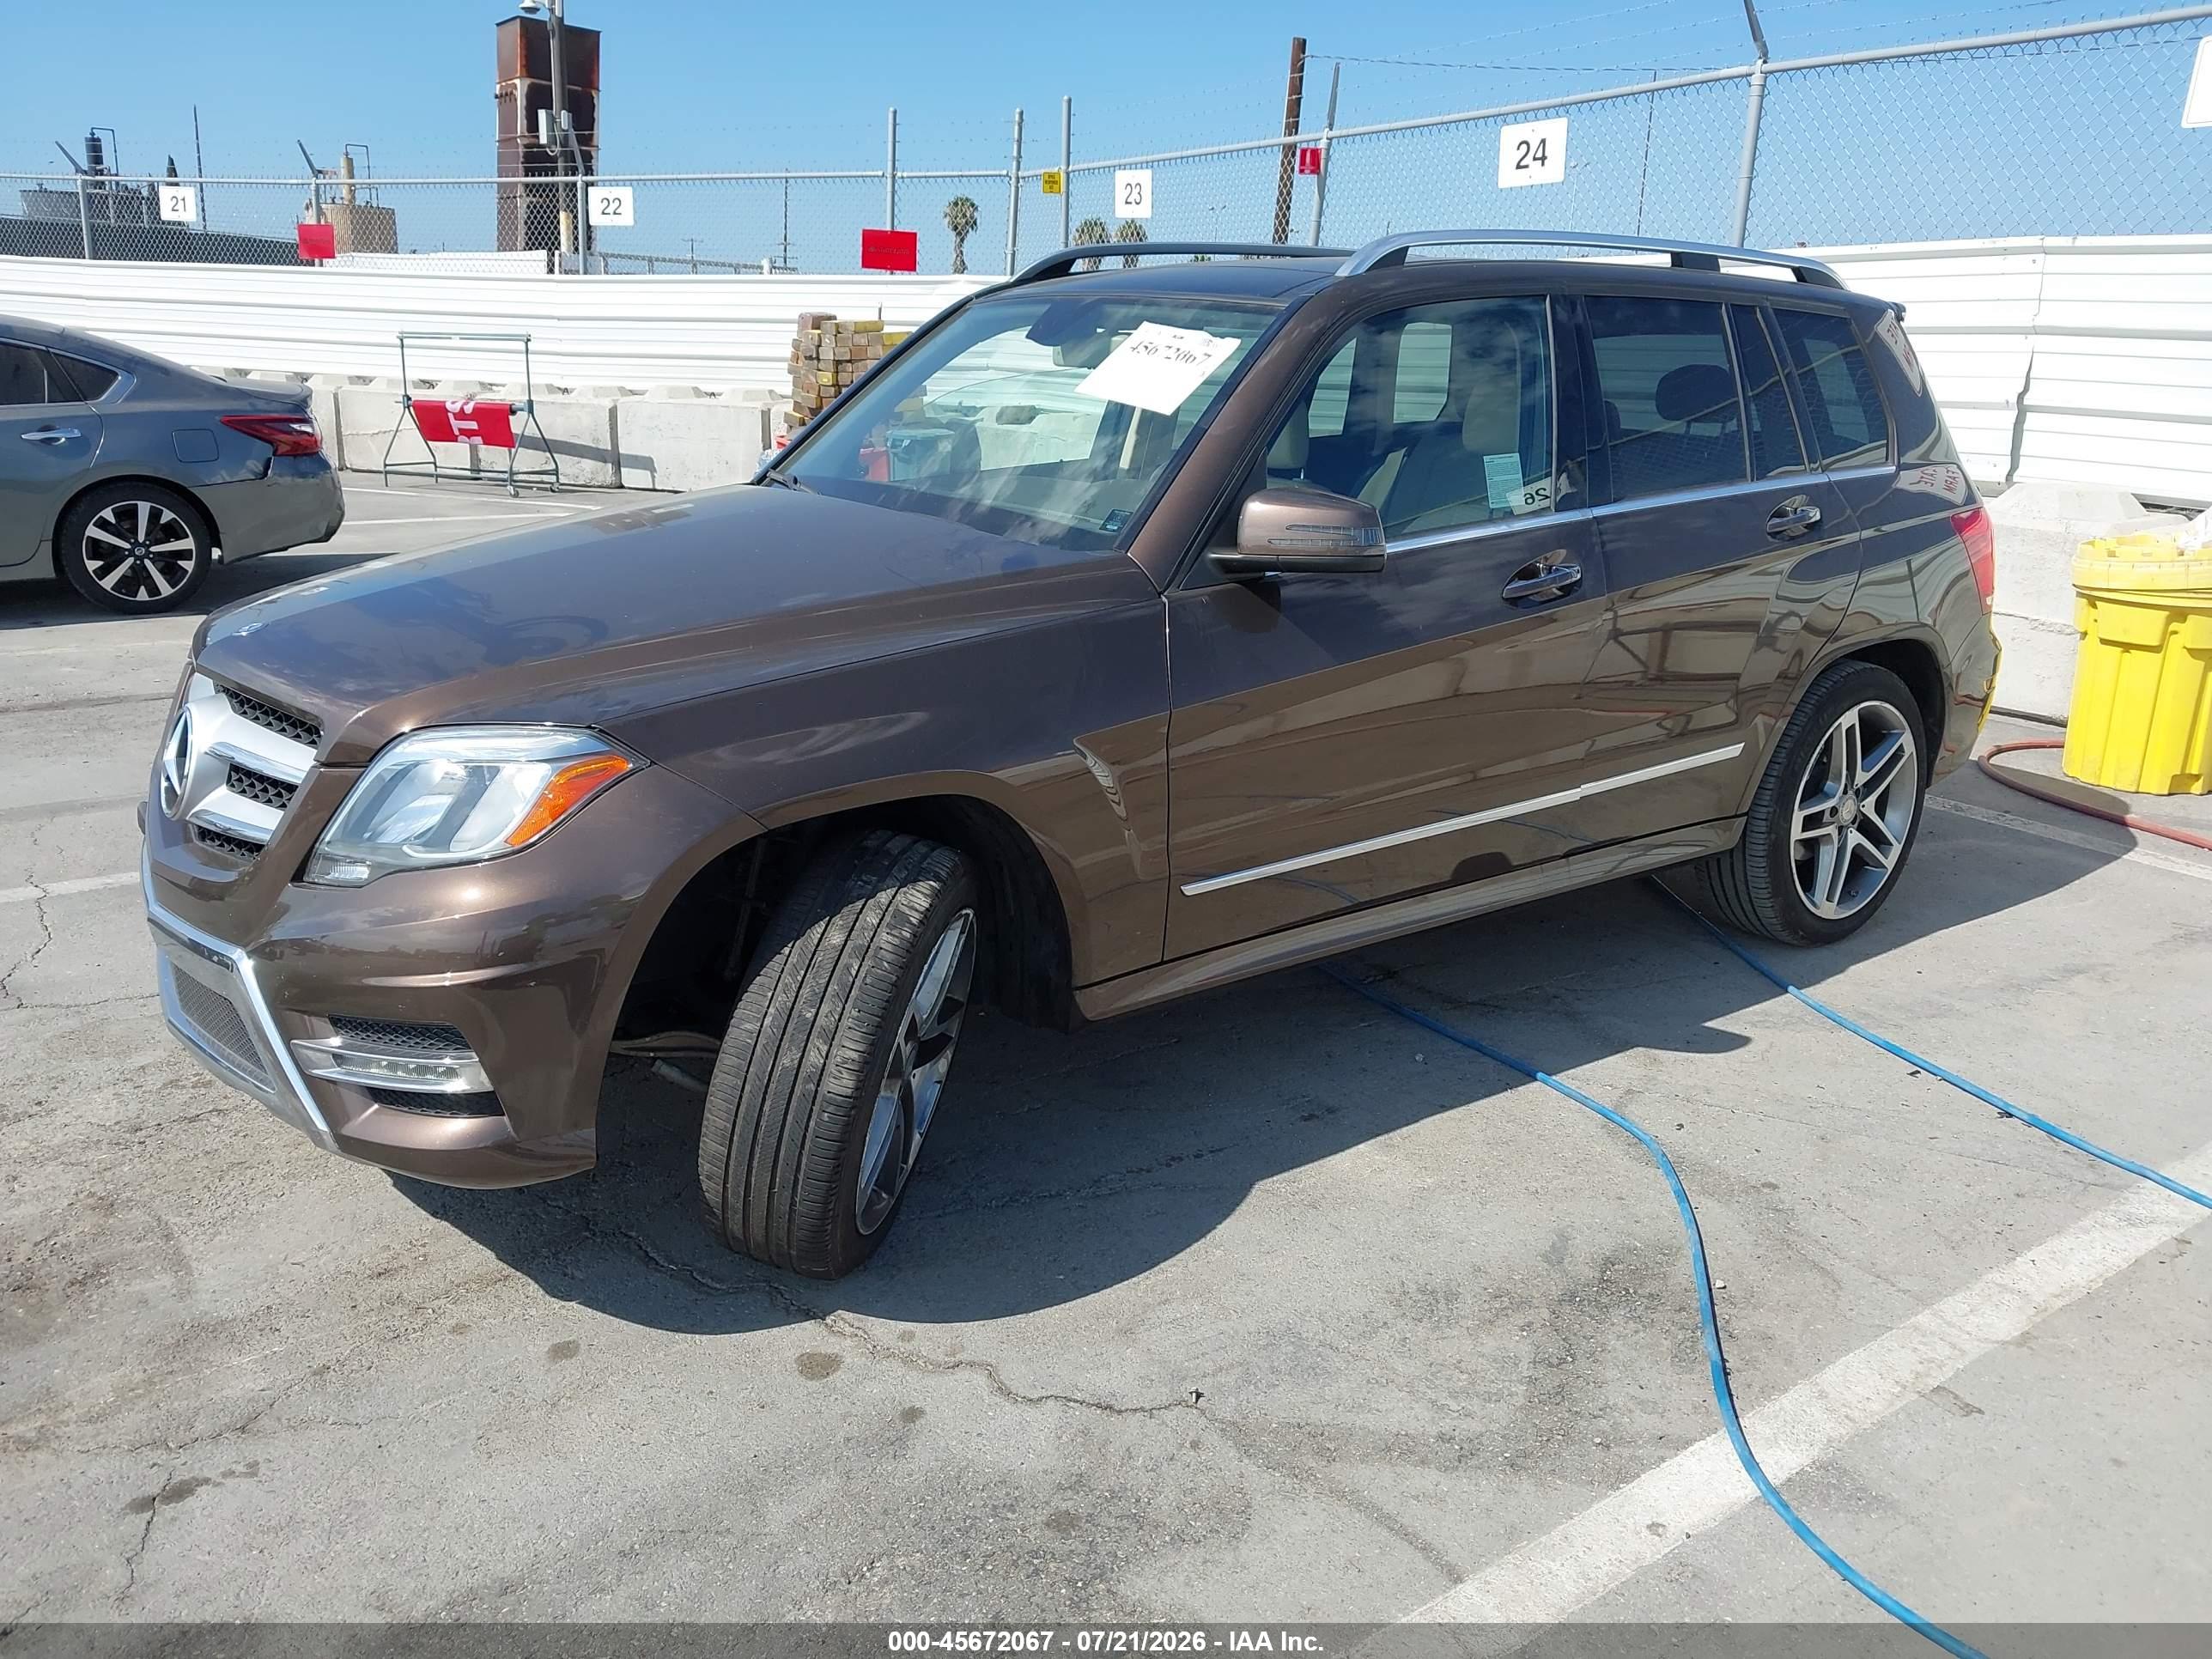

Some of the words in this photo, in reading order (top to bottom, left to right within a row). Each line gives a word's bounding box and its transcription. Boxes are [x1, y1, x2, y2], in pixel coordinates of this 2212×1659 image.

[1516, 137, 1547, 170] 24
[170, 195, 186, 212] 21
[1125, 182, 1142, 205] 23
[600, 197, 622, 216] 22
